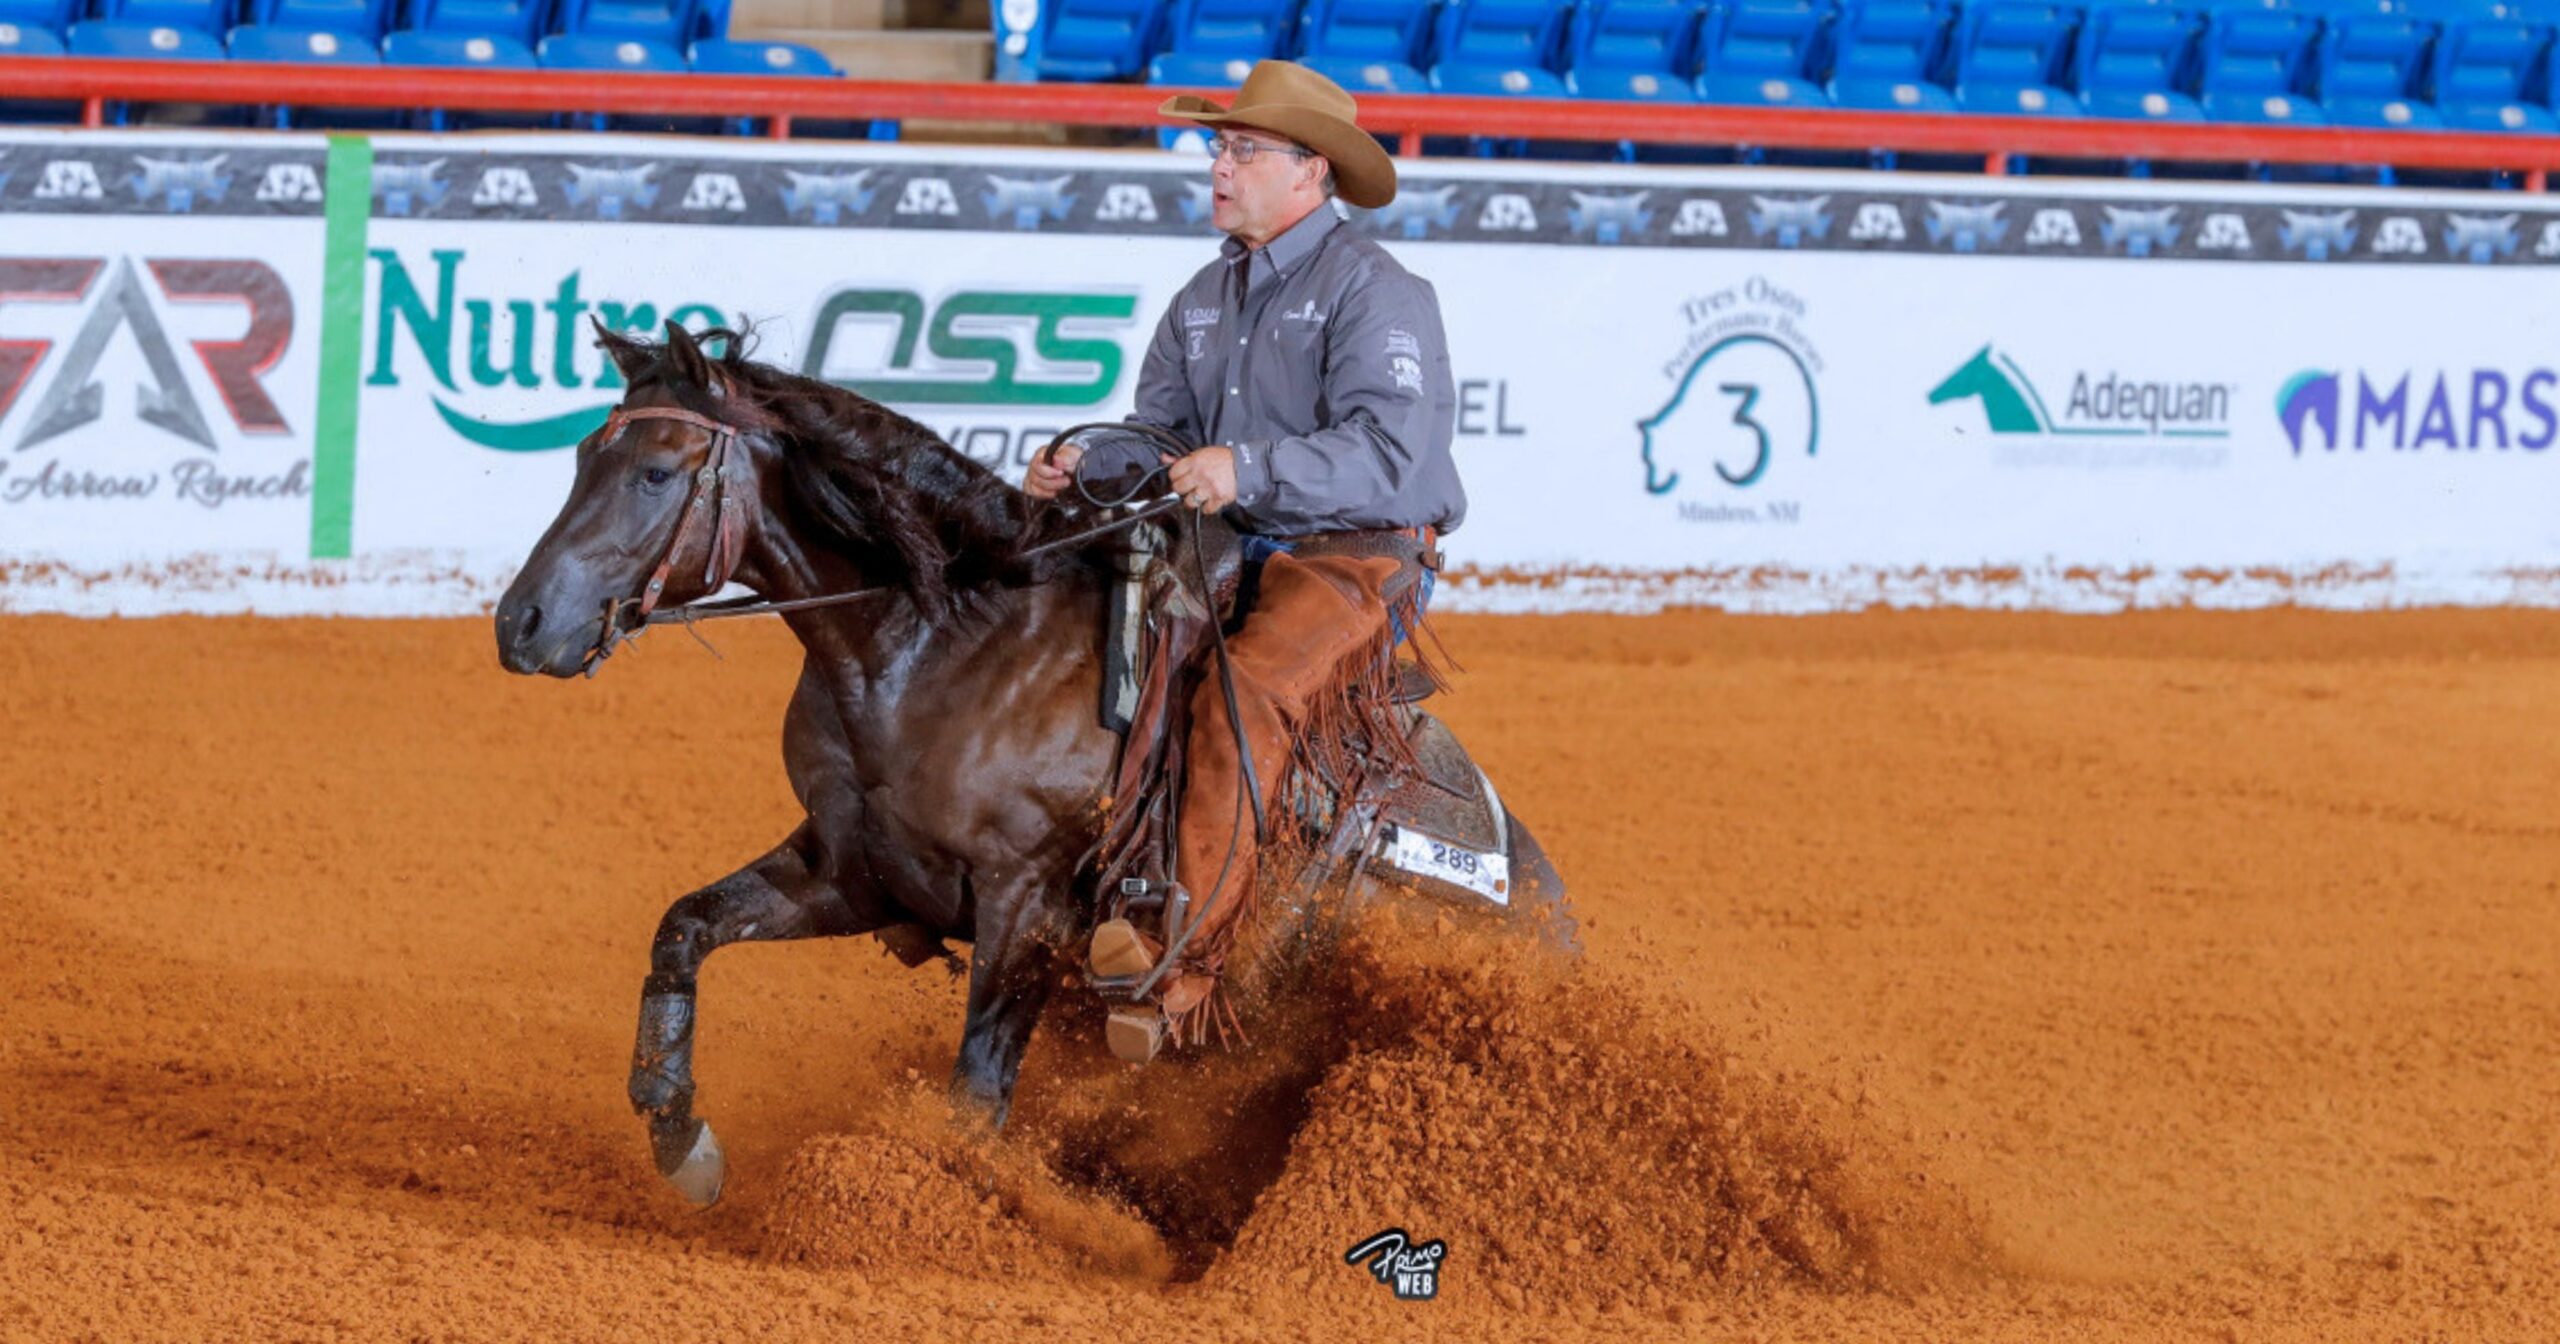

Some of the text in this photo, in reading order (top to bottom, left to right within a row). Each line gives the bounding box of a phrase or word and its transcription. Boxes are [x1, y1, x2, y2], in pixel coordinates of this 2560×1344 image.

[1681, 290, 1736, 326] Tres
[2066, 371, 2228, 435] Adequan
[2353, 366, 2558, 451] MARS
[1713, 382, 1771, 487] 3
[2, 457, 158, 503] Arrow
[171, 457, 314, 510] Ranch
[1432, 841, 1477, 875] 289
